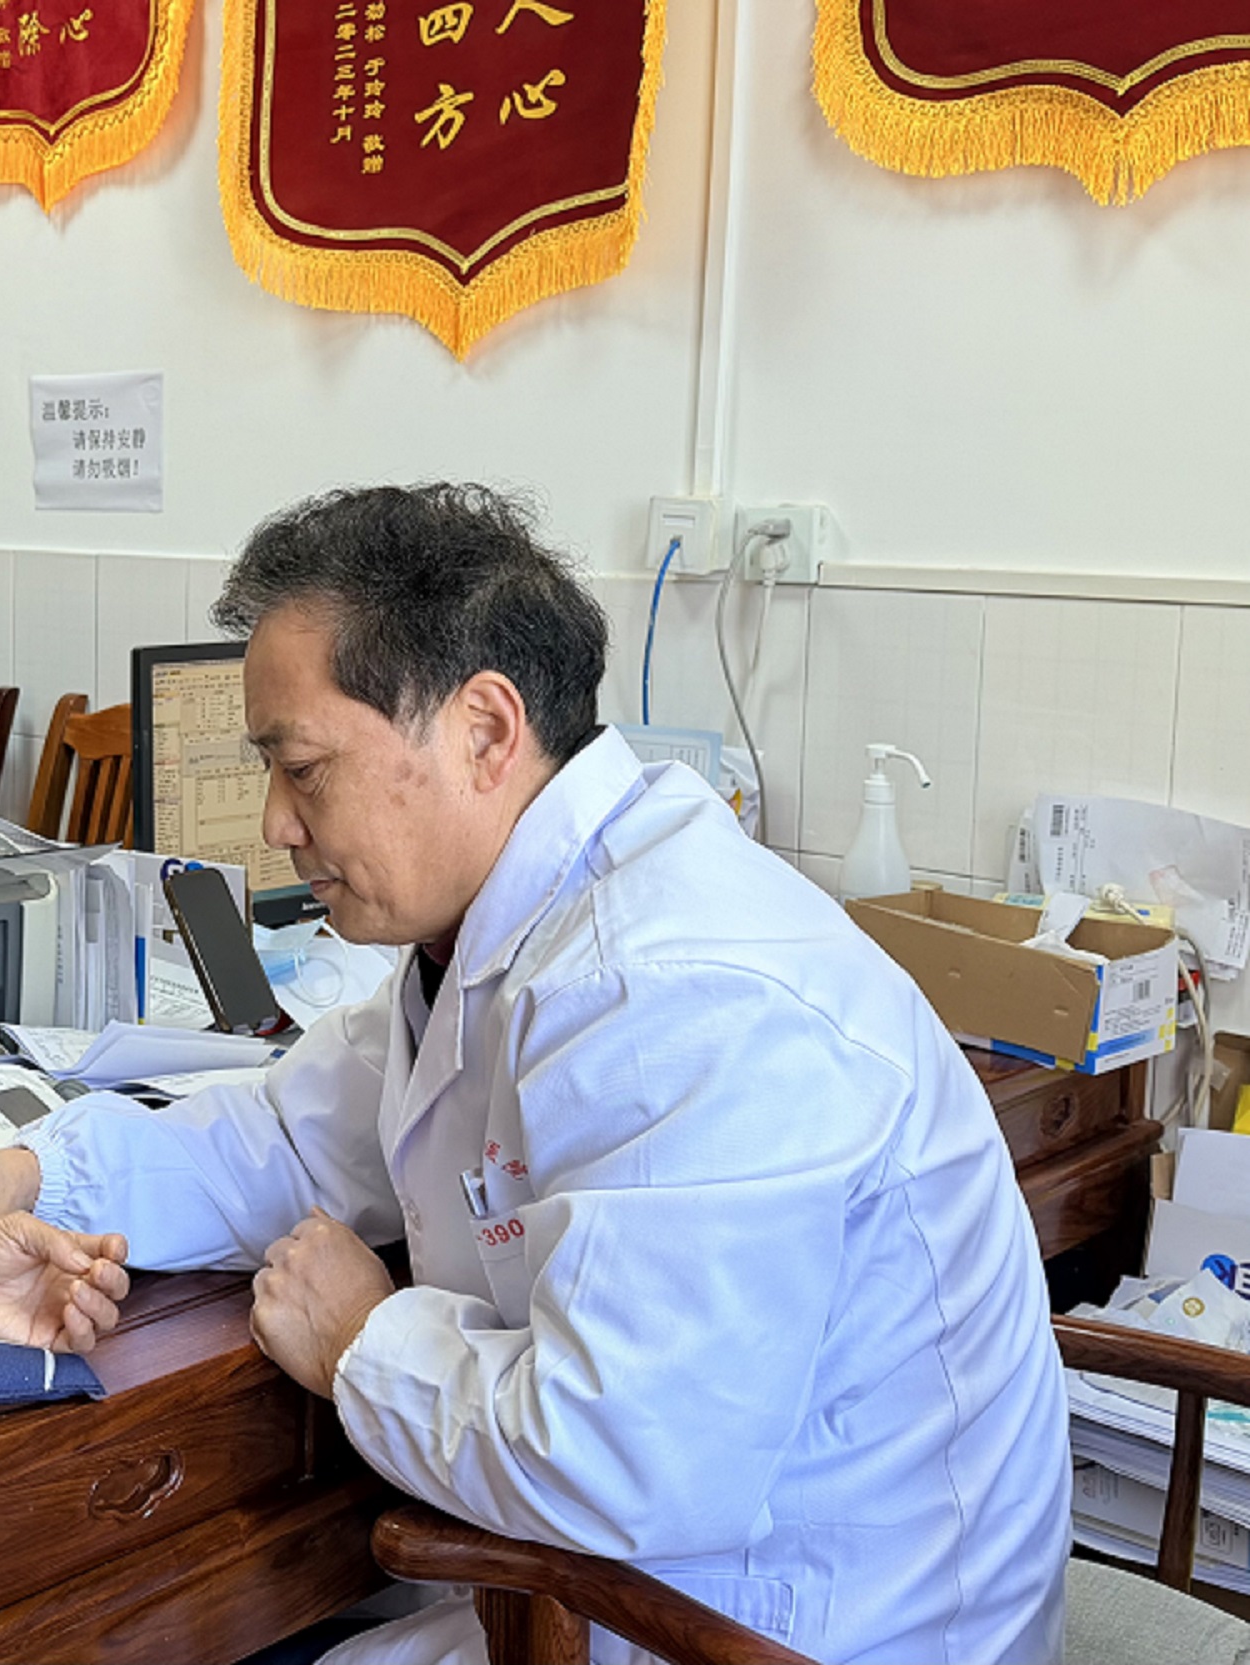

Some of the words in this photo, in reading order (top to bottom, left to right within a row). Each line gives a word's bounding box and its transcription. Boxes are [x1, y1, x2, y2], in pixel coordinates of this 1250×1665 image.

[414, 1, 475, 150] 四方
[494, 0, 575, 125] 人心
[72, 427, 146, 451] 请保持安静
